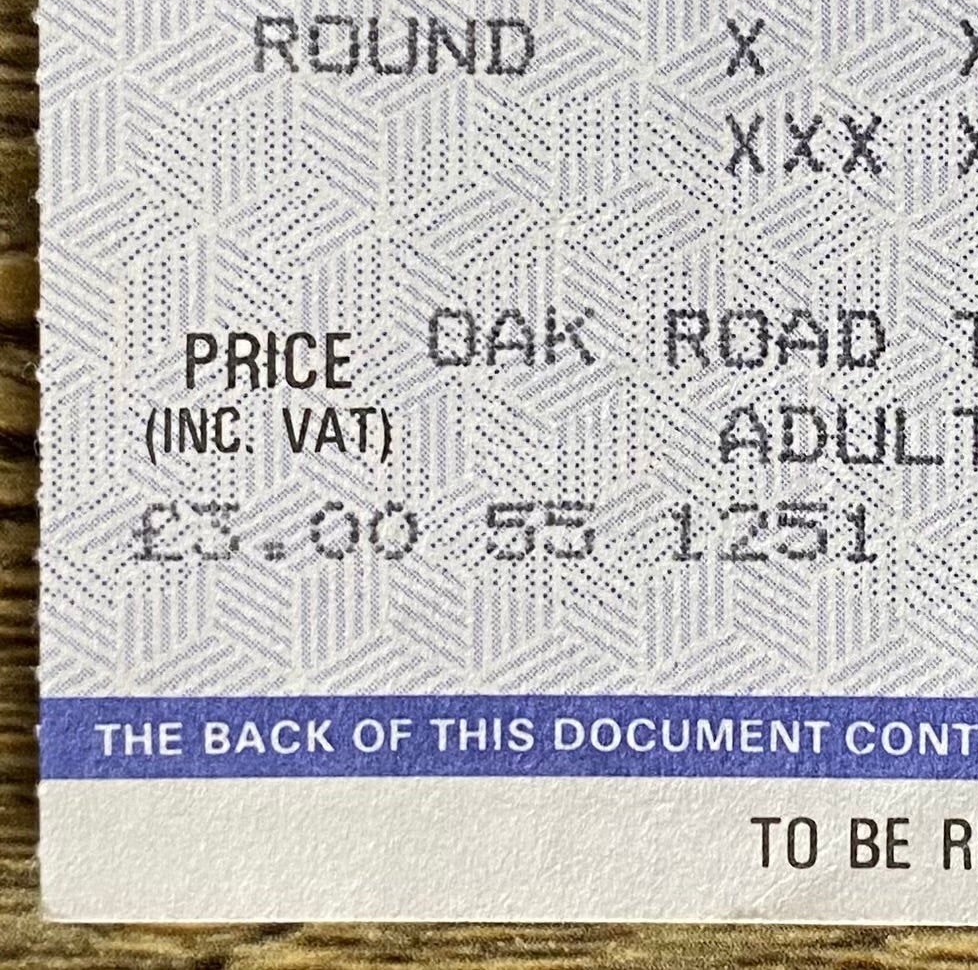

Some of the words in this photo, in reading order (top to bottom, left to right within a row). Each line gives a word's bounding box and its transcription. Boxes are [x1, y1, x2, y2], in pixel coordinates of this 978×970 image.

[252, 15, 536, 77] ROUND
[725, 18, 765, 78] X
[724, 114, 883, 174] XXX
[184, 332, 352, 391] PRICE
[427, 306, 595, 368] OAK
[664, 308, 887, 370] ROAD
[145, 407, 254, 462] (INC.
[282, 407, 393, 462] VAT)
[131, 500, 420, 564] £3.00
[484, 500, 596, 563] 55
[672, 500, 878, 564] 1251
[97, 722, 183, 756] THE
[205, 719, 334, 755] BACK
[352, 718, 413, 754] OF
[431, 718, 535, 753] THIS
[552, 718, 830, 754] DOCUMENT
[751, 817, 818, 871] TO
[848, 817, 910, 871] BE
